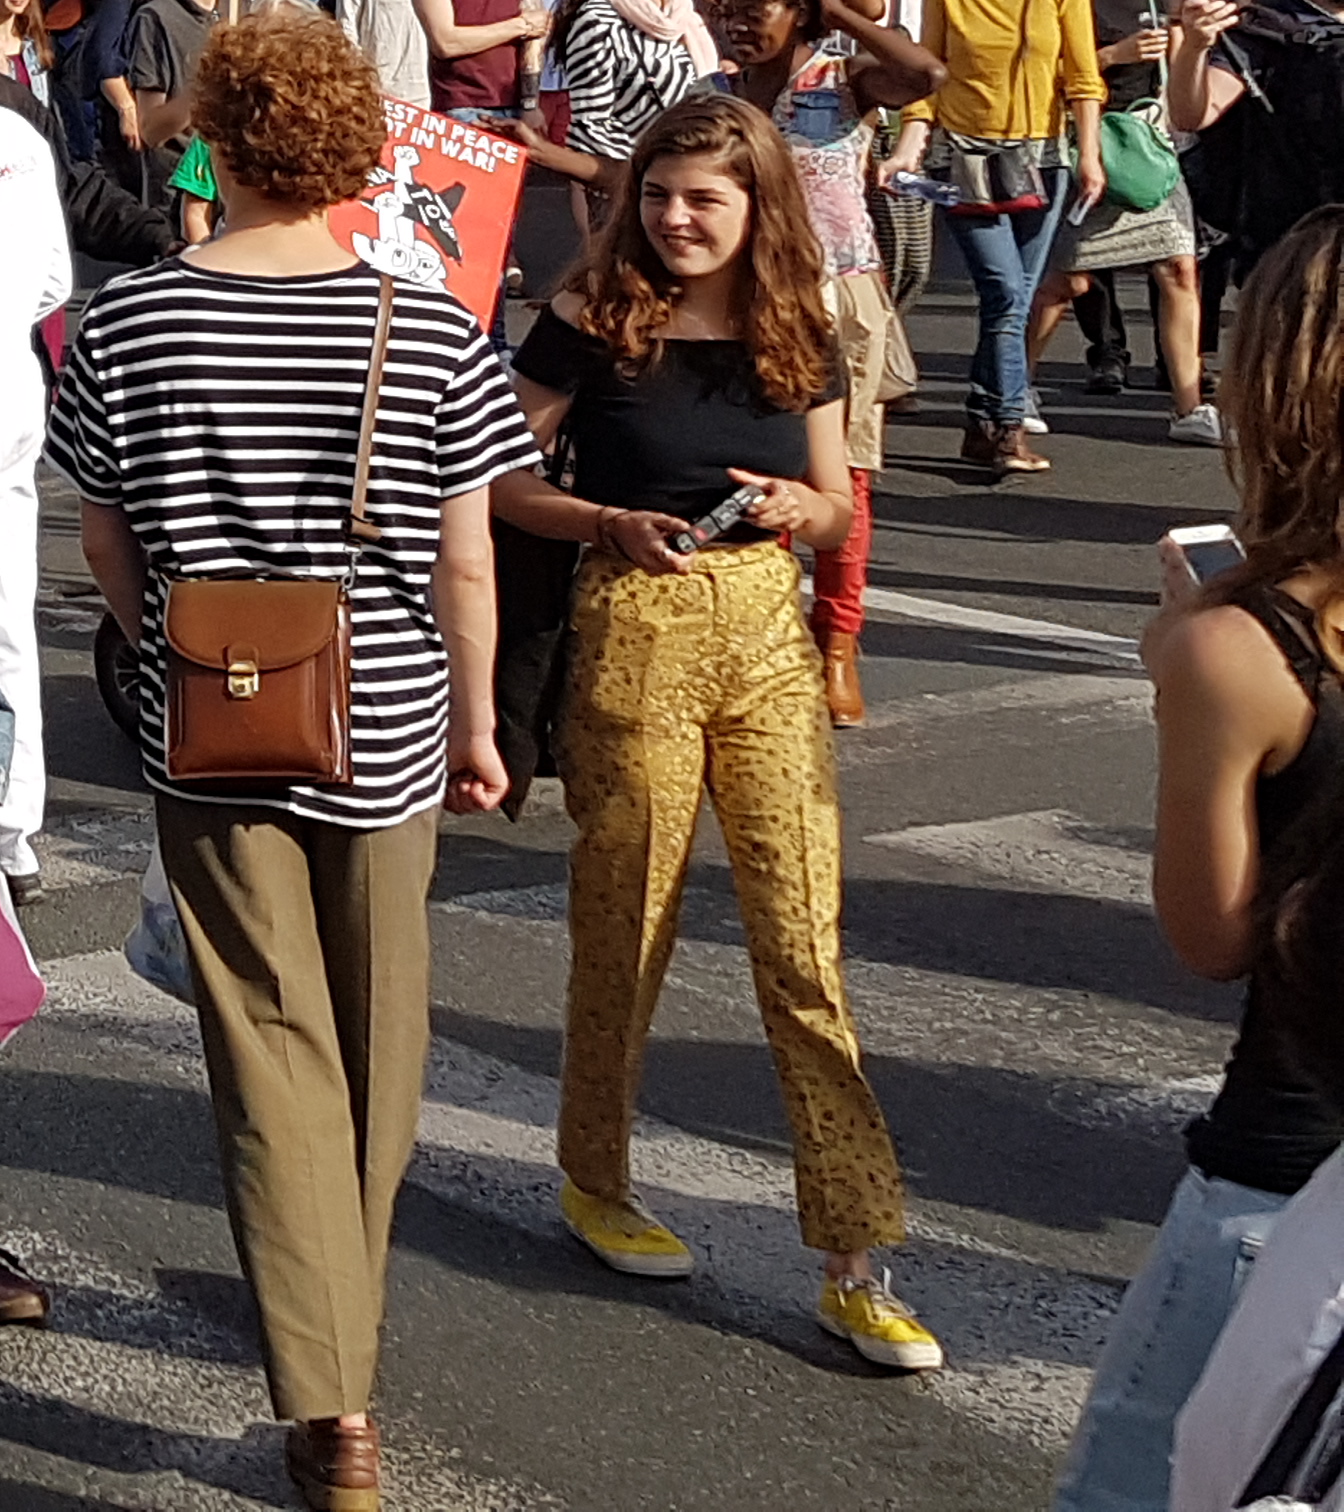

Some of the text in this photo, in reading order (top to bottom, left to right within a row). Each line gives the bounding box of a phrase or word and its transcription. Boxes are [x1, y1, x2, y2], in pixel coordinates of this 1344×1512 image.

[384, 100, 519, 164] EST IN PEACE
[410, 127, 434, 149] IN
[441, 137, 496, 172] WAR!
